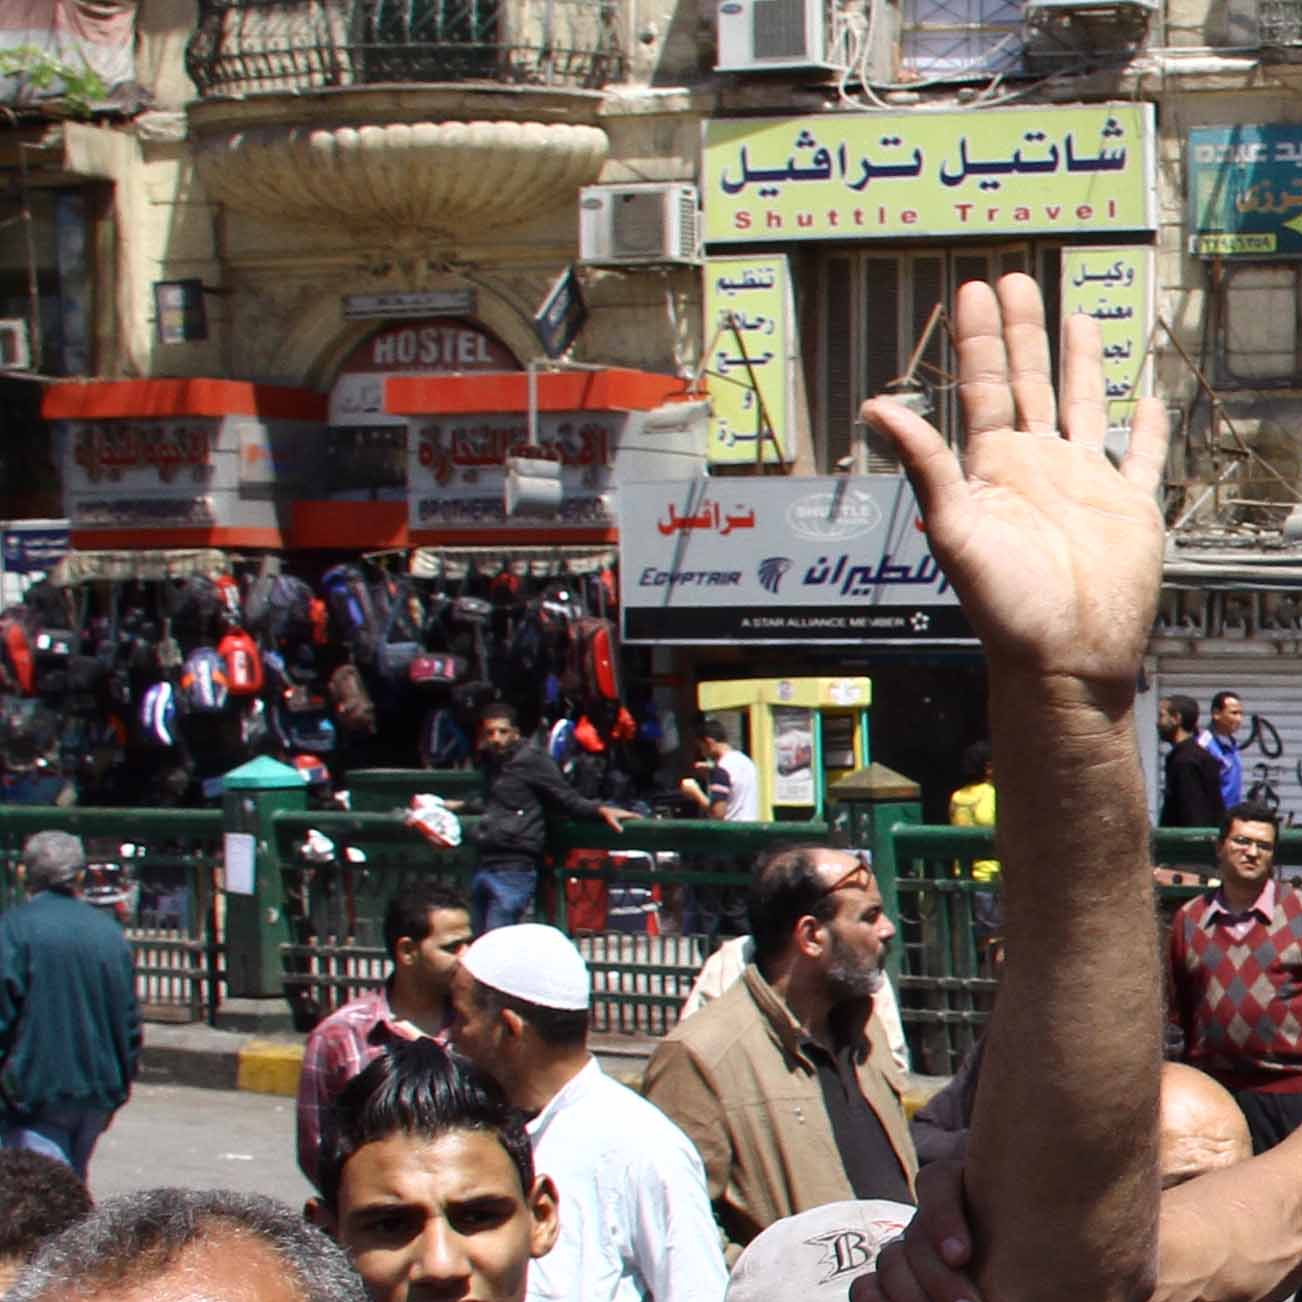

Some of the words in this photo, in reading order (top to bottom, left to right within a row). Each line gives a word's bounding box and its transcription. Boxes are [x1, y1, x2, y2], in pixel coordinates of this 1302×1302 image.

[939, 117, 1127, 191] شاتيل
[734, 205, 919, 231] Shuttle
[953, 199, 1117, 224] Travel
[715, 267, 775, 296] تنظيم
[1073, 260, 1135, 288] وكيل
[373, 327, 494, 365] HOSTEL
